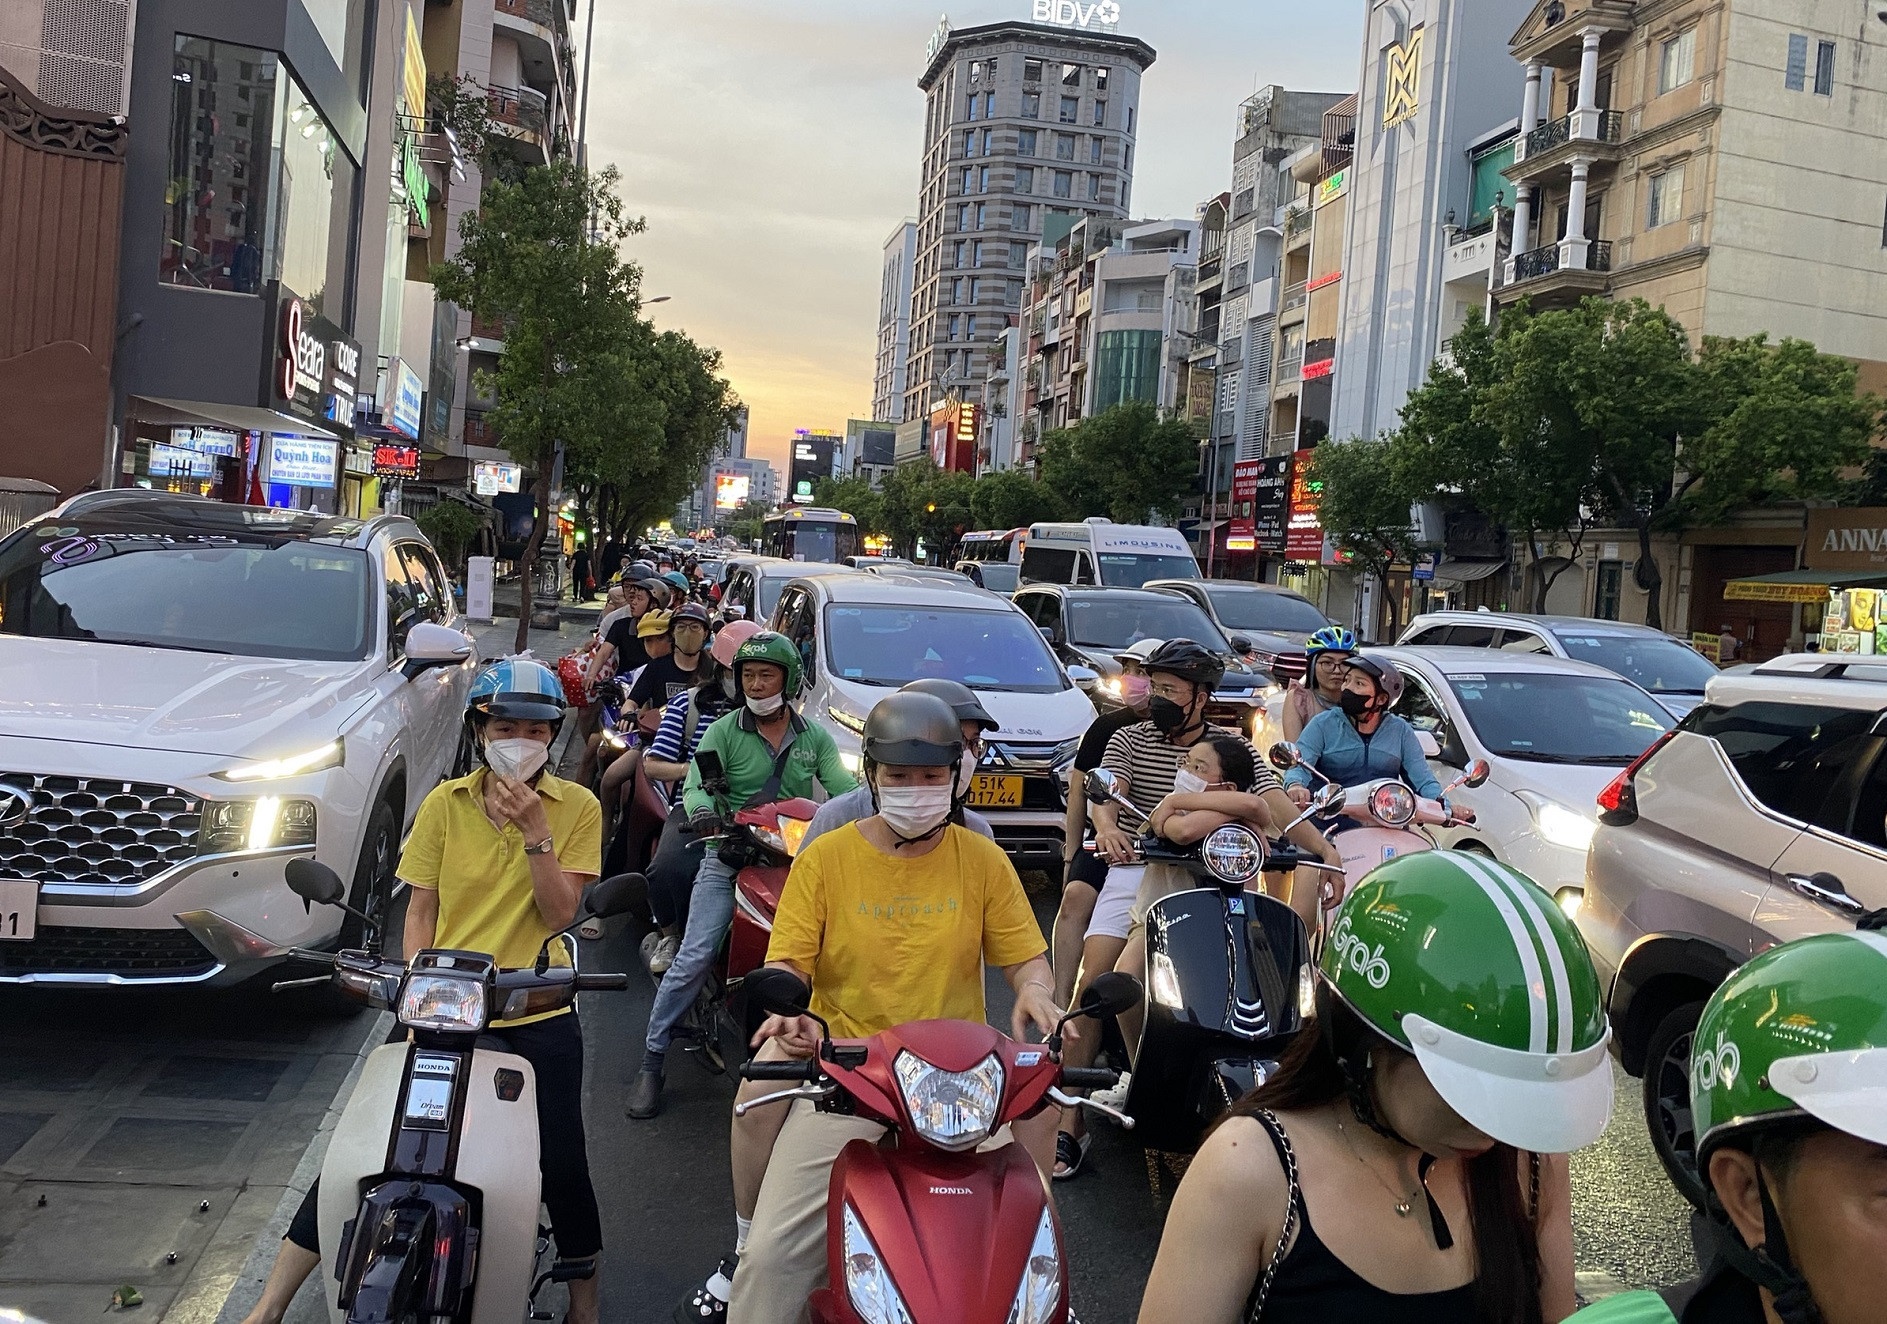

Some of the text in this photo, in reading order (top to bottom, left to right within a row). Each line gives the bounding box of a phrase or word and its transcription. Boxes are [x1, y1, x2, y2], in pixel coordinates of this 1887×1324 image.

[1033, 0, 1098, 27] BIDV
[285, 300, 325, 399] Seara
[338, 341, 359, 378] CORE
[335, 393, 355, 428] TRUE
[274, 448, 332, 464] Quỳnh Hoa
[1105, 540, 1183, 551] LIMOUSINE
[742, 643, 768, 656] Grab
[791, 748, 817, 762] Grab
[980, 777, 1005, 790] 51K
[967, 791, 1015, 804] 017.44
[857, 896, 957, 920] Approach
[0, 912, 19, 936] 1
[1333, 915, 1391, 989] Grab
[417, 1063, 451, 1071] HONDA
[929, 1186, 974, 1195] HONDA
